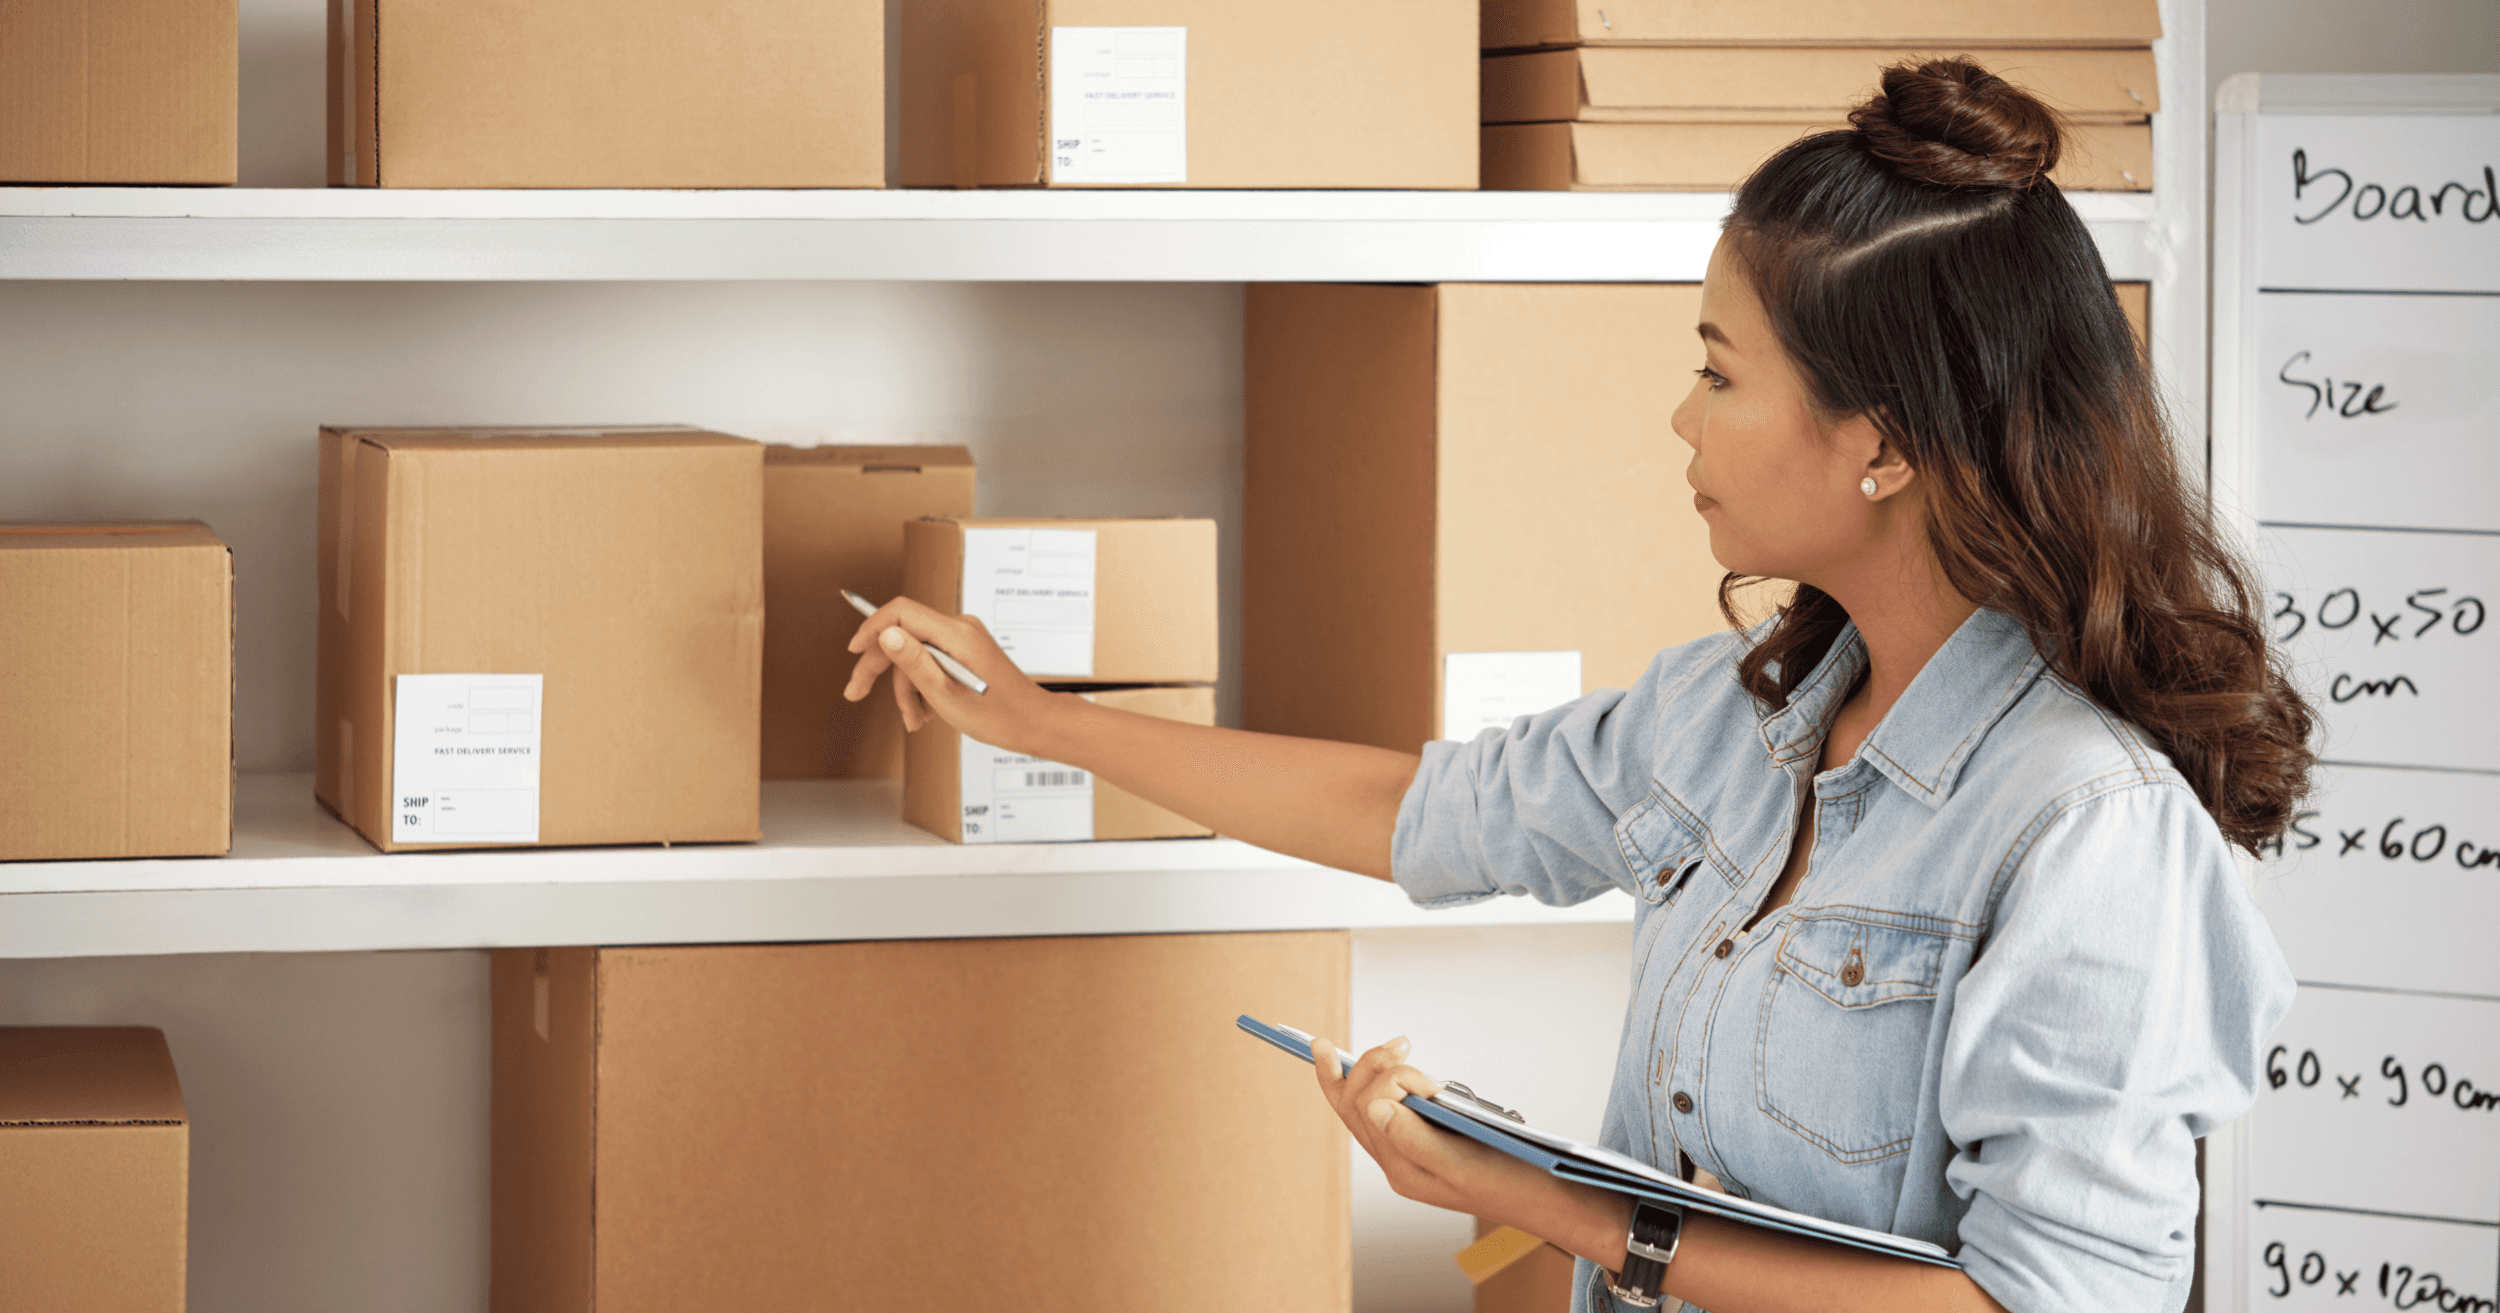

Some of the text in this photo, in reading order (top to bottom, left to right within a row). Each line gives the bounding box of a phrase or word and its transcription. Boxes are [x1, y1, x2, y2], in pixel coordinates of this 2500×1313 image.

[1057, 139, 1081, 150] SHIP
[2293, 147, 2500, 224] Board
[2280, 351, 2399, 420] Size
[995, 588, 1015, 596] FAST
[2330, 673, 2419, 704] cm
[434, 747, 532, 756] FAST DELIVERY SERVICE
[403, 797, 429, 808] SHIP
[965, 805, 989, 817] SHIP
[403, 814, 422, 826] TO:
